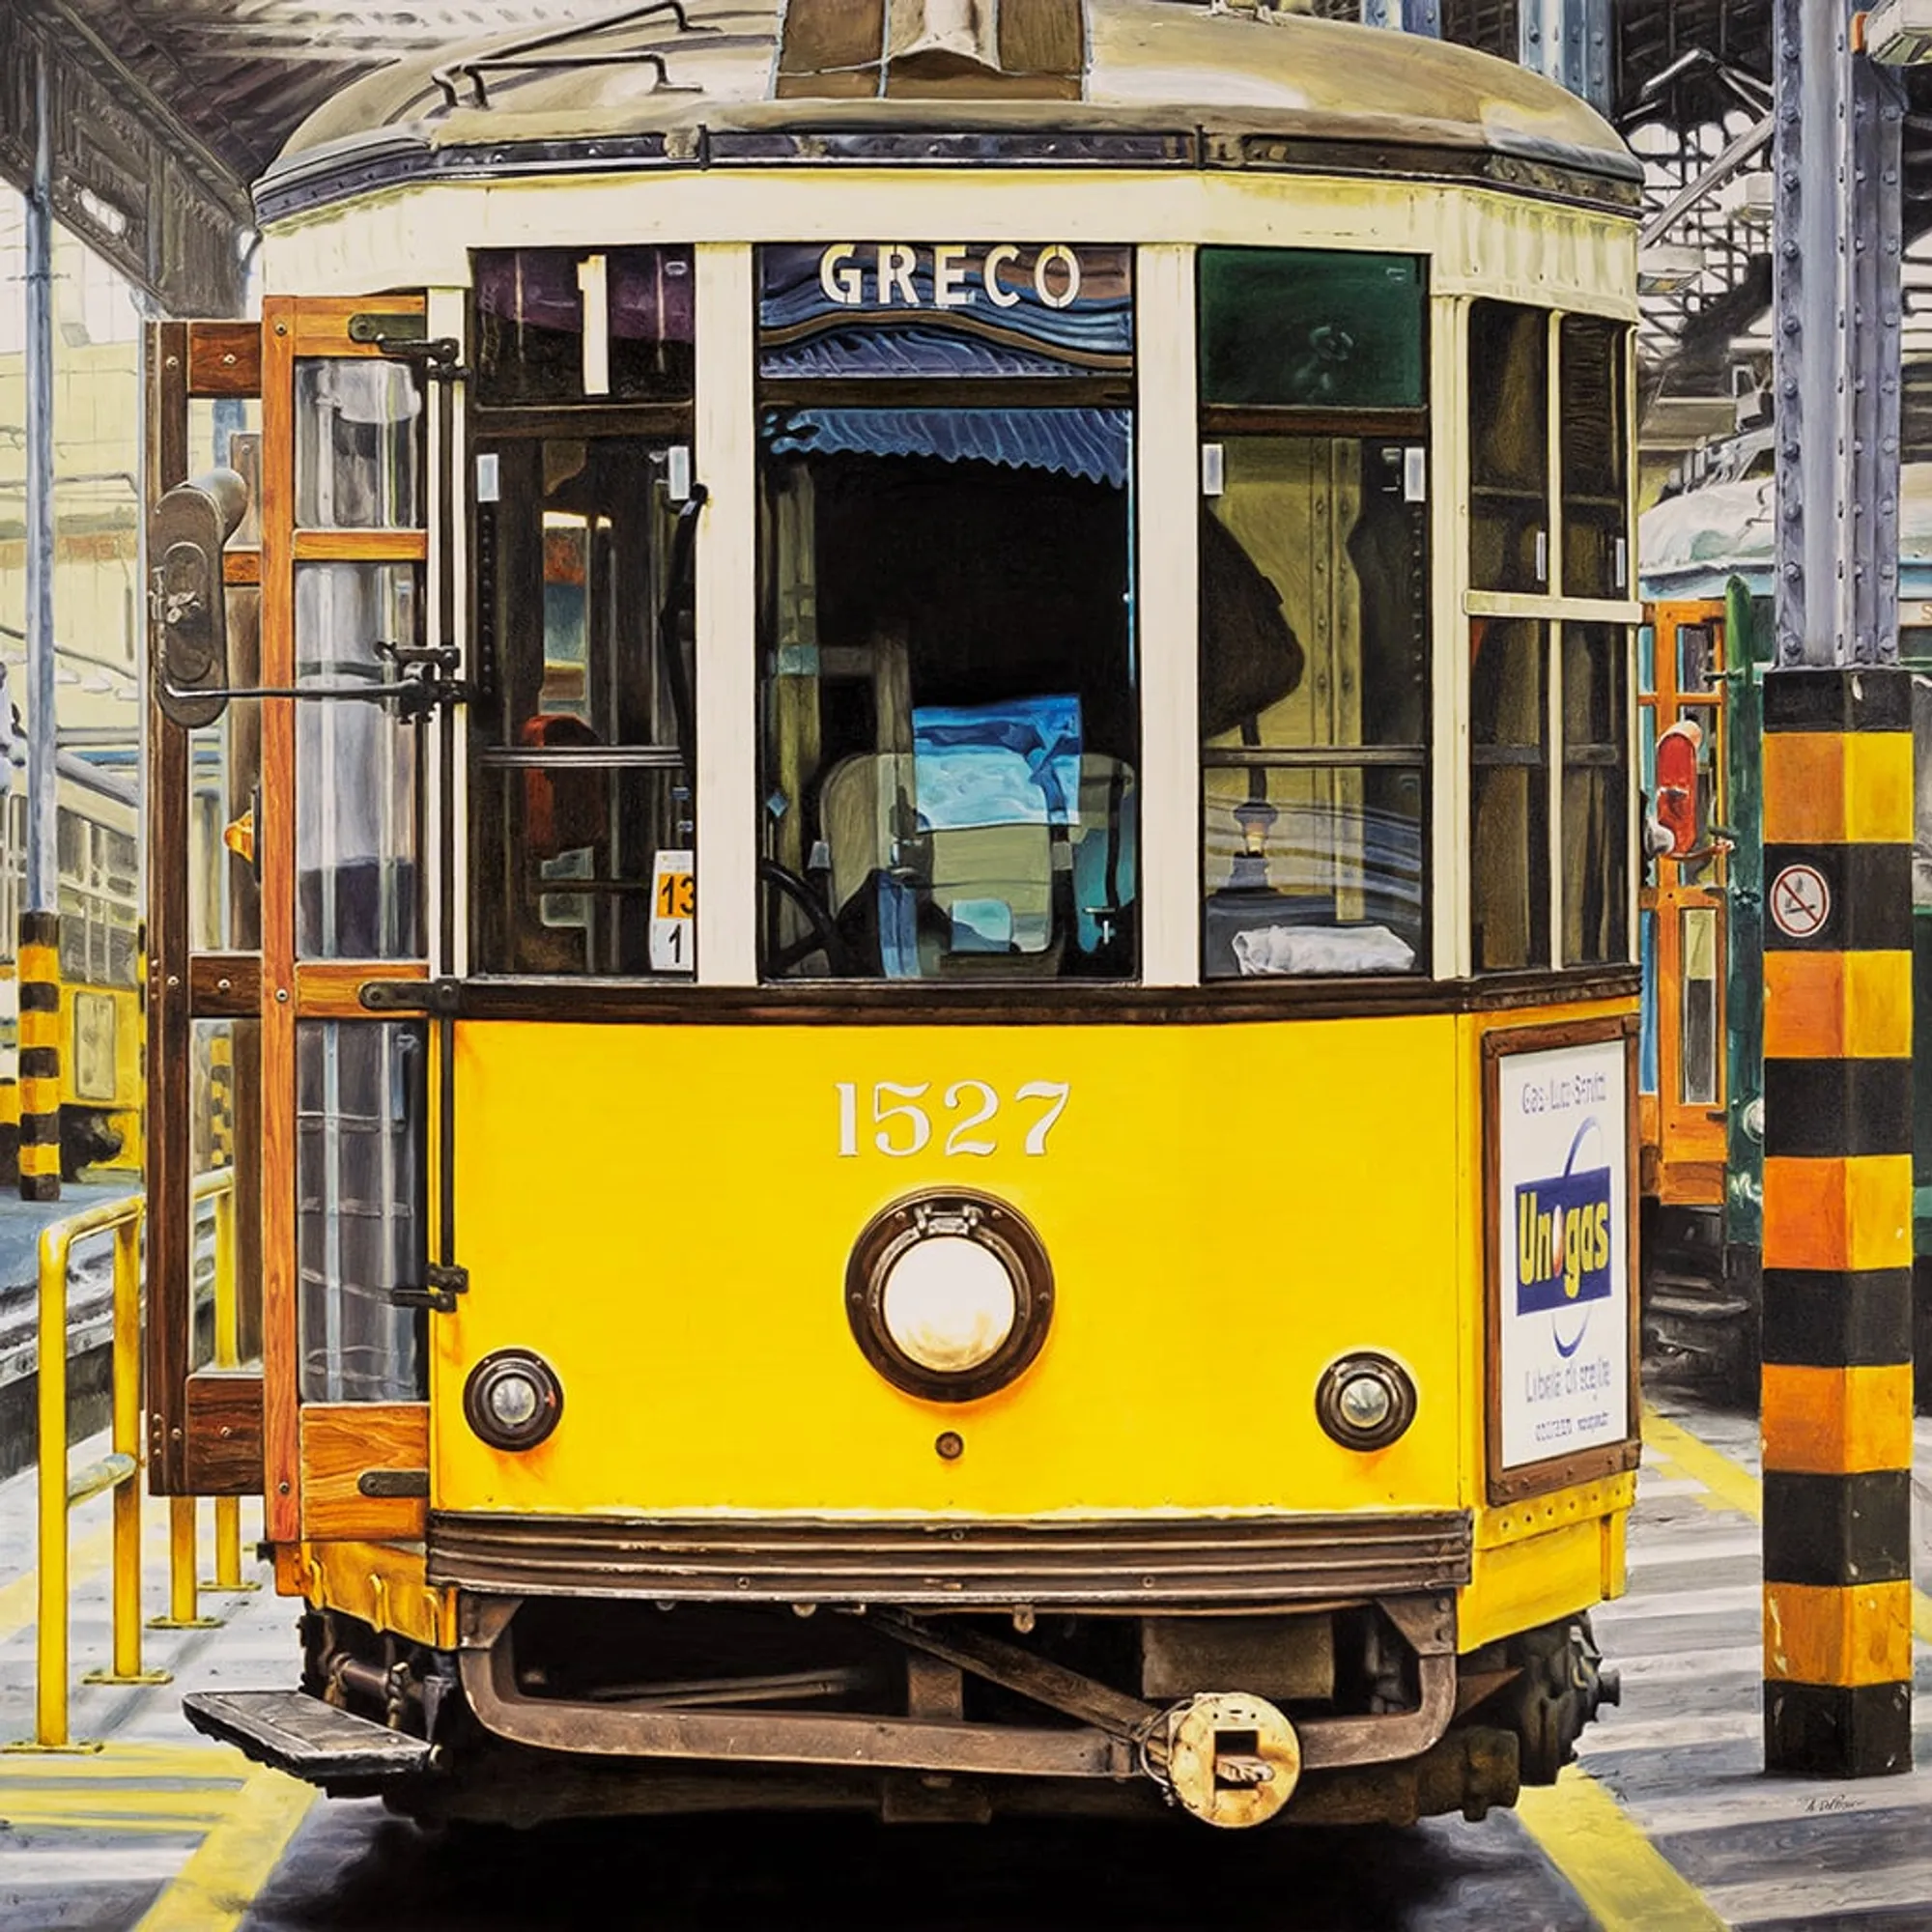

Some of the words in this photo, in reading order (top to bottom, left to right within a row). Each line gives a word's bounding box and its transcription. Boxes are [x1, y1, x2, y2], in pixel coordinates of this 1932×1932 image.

[820, 243, 1081, 308] GRECO
[577, 254, 610, 395] 1
[662, 875, 695, 915] 13
[668, 923, 681, 964] 1
[835, 1080, 1071, 1157] 1527
[1519, 1191, 1609, 1298] Unigas
